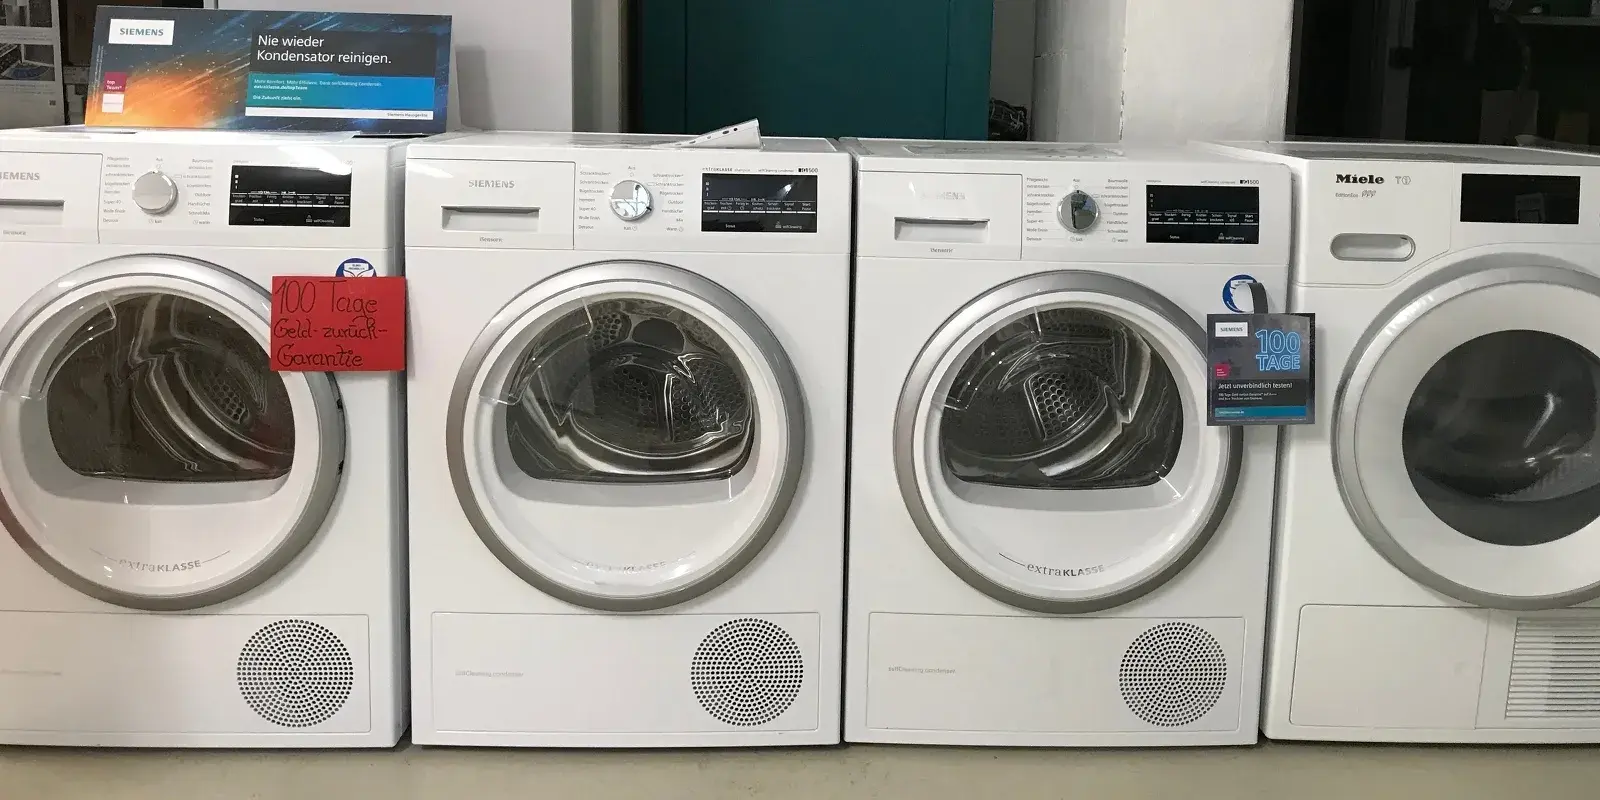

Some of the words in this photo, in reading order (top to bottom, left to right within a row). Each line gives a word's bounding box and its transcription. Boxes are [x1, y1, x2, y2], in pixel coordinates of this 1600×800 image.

[119, 27, 164, 36] SIEMENS
[257, 34, 279, 47] Nie
[282, 35, 325, 48] wieder
[256, 49, 336, 63] Kondensator
[338, 52, 392, 66] reinigen.
[0, 171, 40, 181] IEMENS
[1335, 173, 1385, 185] Miele
[468, 179, 515, 189] SIEMENS
[274, 279, 317, 315] 100
[318, 279, 378, 319] Tage
[273, 318, 318, 339] Geld-
[322, 316, 388, 340] zurück-
[1255, 328, 1301, 354] 100
[276, 343, 364, 368] Garantie
[1255, 353, 1301, 372] TAGE
[1217, 382, 1232, 390] Jetzt
[1232, 381, 1272, 389] unverbindlich
[118, 558, 202, 573] extraKLASSE
[1026, 561, 1105, 577] extraKLASSE
